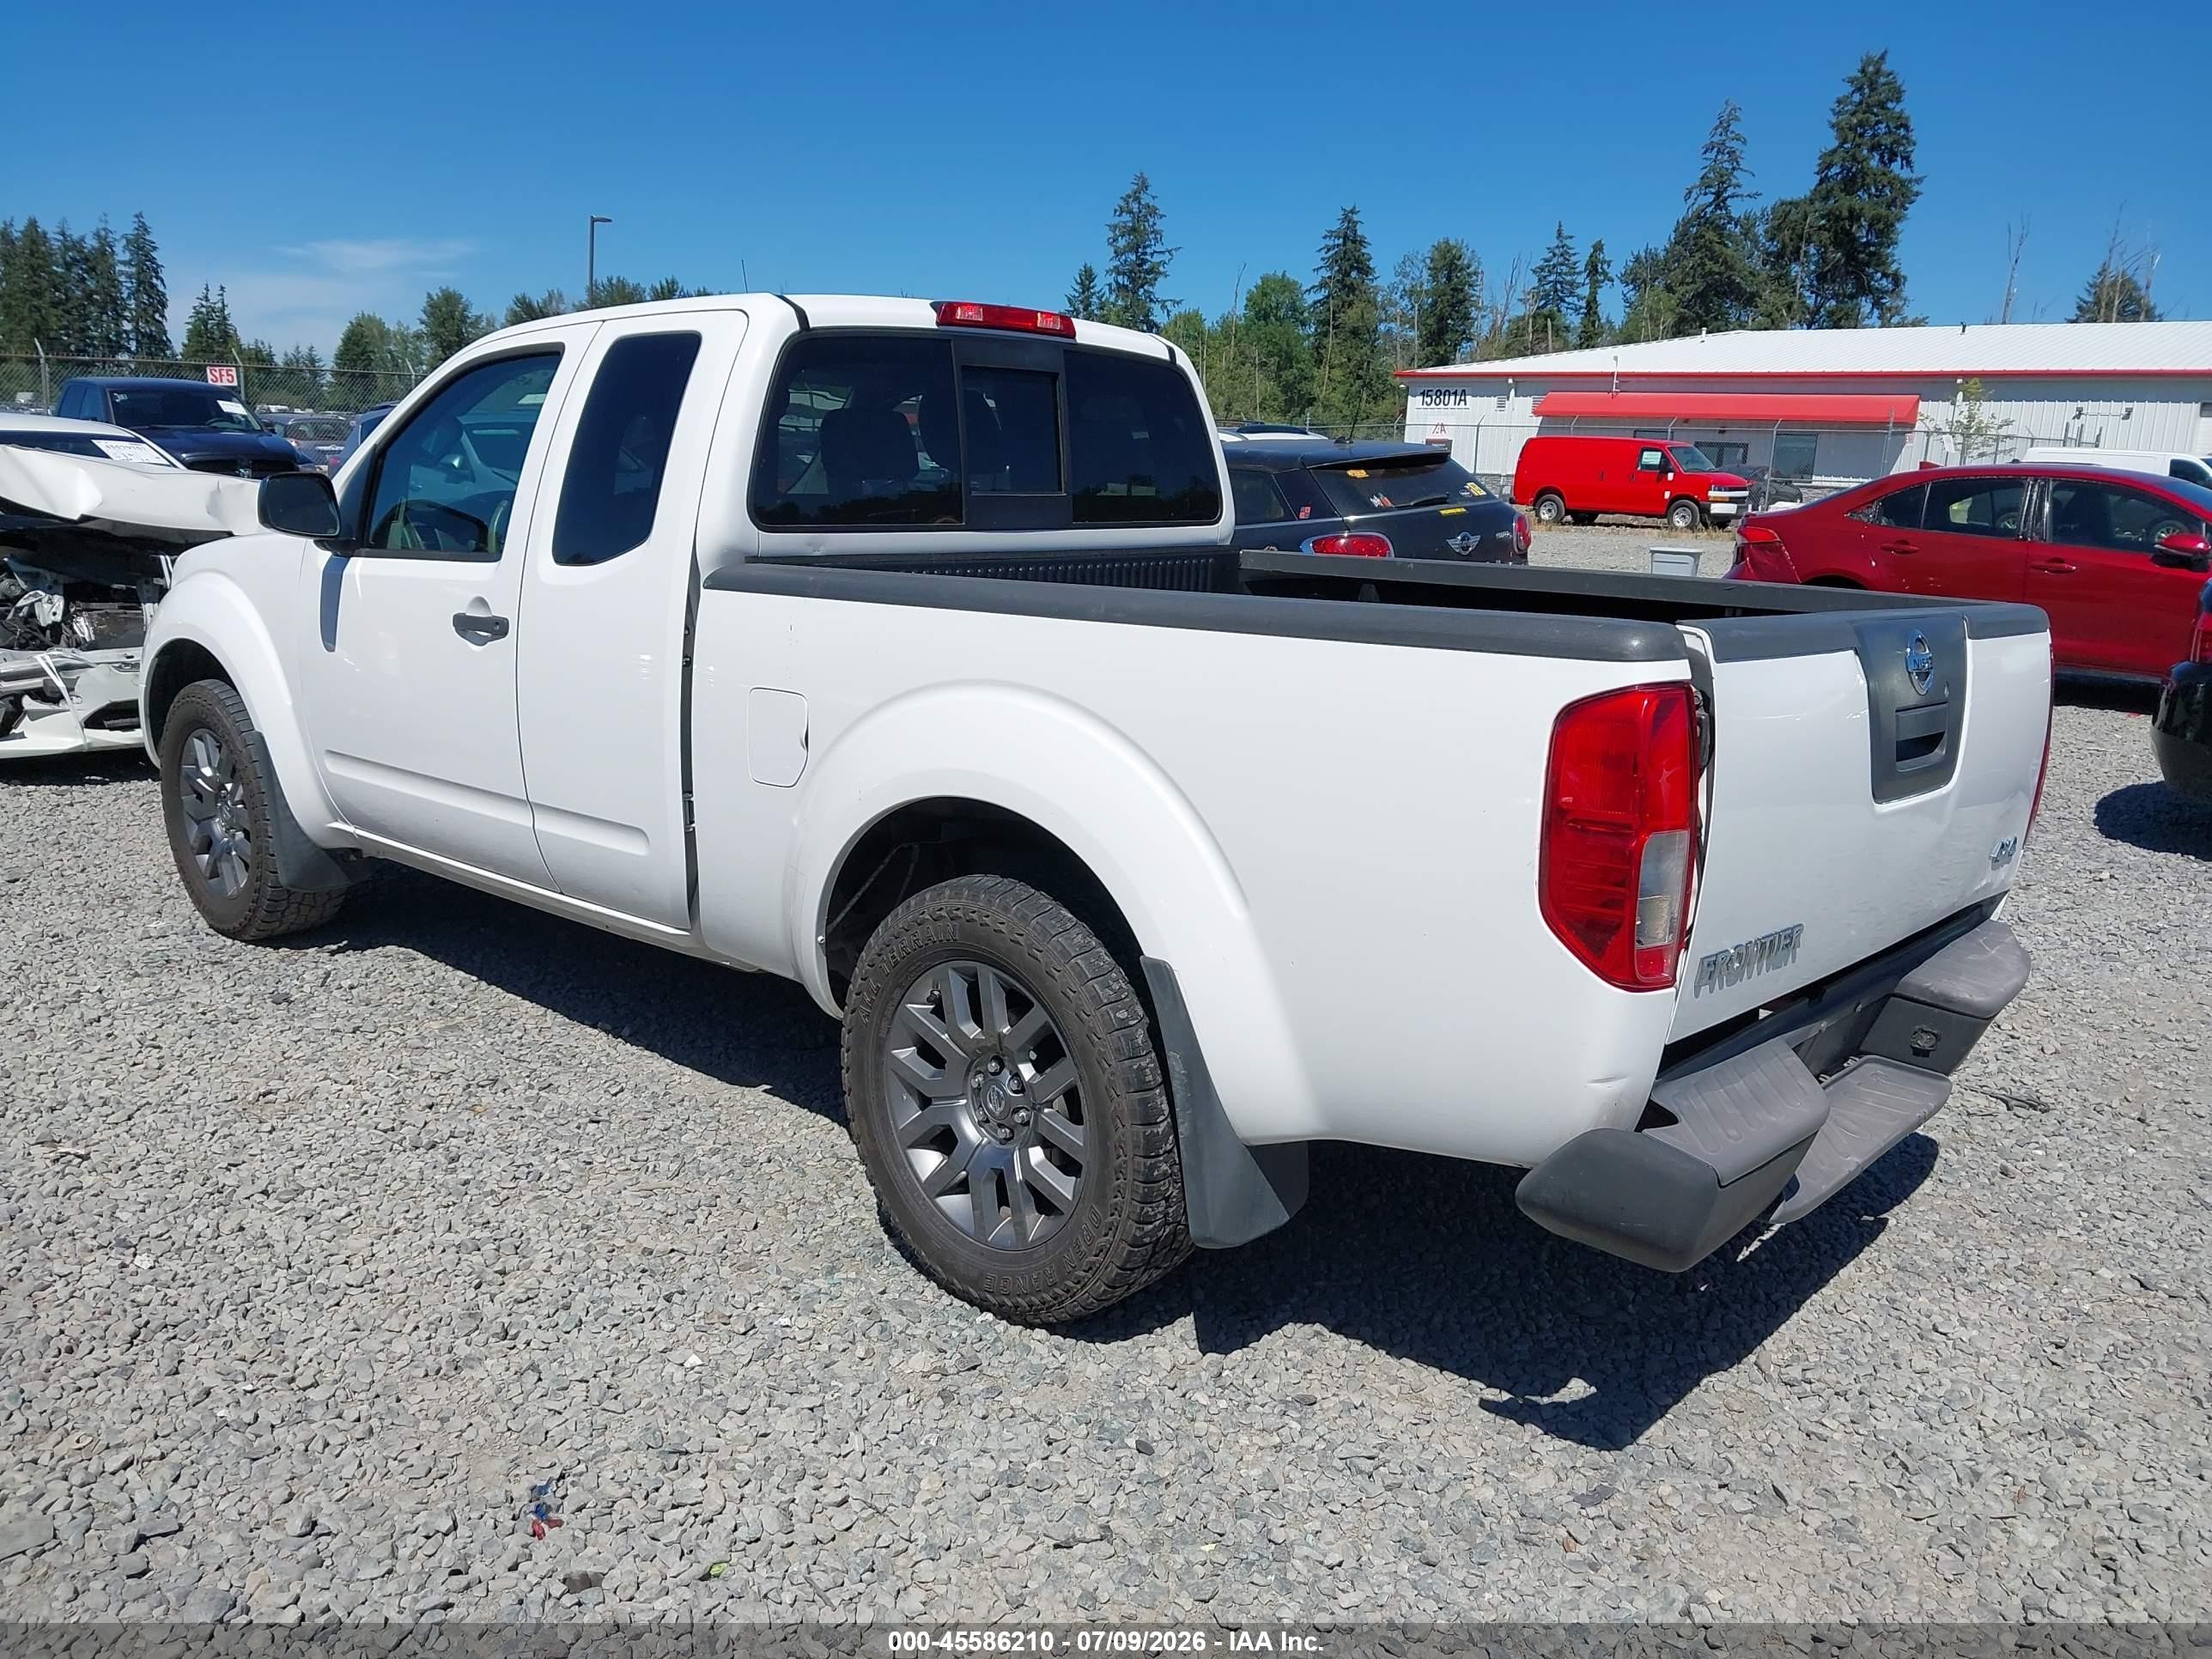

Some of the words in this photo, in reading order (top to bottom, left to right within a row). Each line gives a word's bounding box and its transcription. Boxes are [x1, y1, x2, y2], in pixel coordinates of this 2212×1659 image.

[209, 368, 234, 384] SF5
[1419, 389, 1468, 406] 15801A
[858, 977, 882, 1025] ALL
[878, 922, 960, 977] TERRAIN
[1695, 923, 1804, 996] FRONTIER
[1063, 1203, 1102, 1275] OPEN
[984, 1263, 1059, 1295] RANGE
